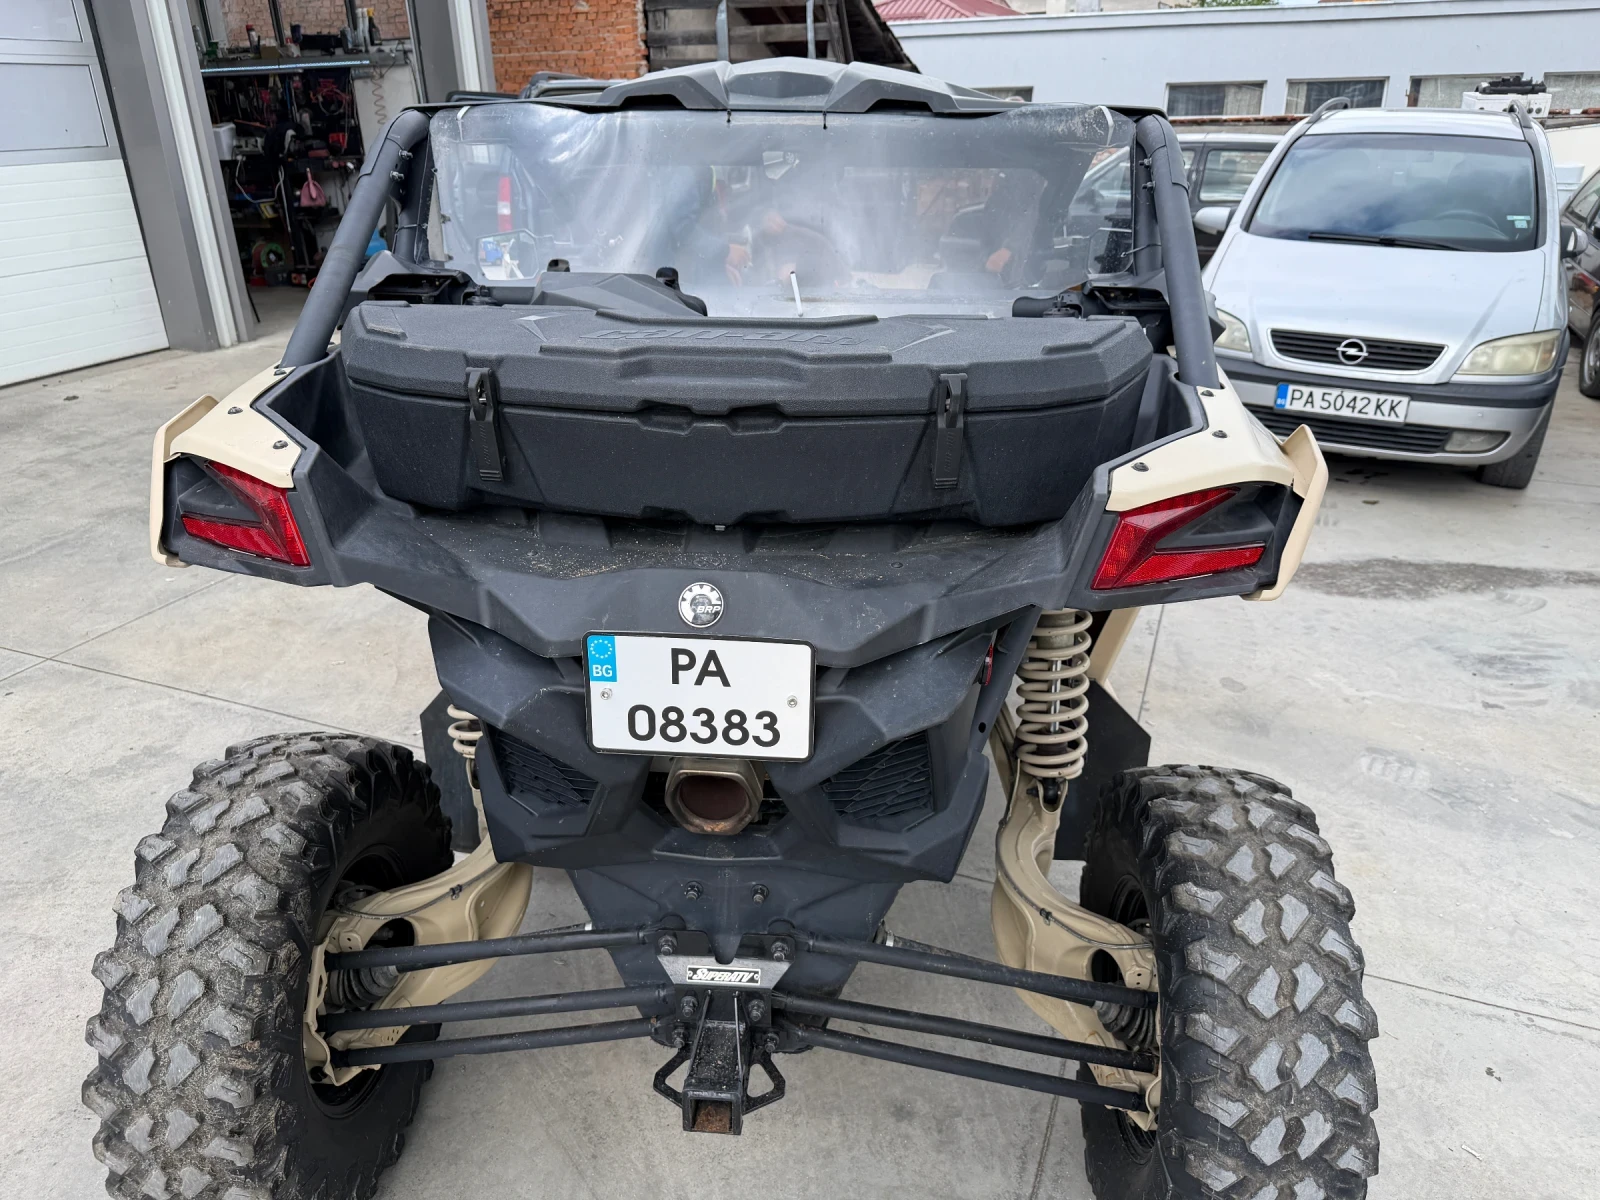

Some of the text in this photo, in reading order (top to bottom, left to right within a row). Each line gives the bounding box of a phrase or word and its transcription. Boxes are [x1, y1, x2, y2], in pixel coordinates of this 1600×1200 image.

[1289, 389, 1402, 418] PA 5042 KK
[696, 605, 722, 614] BRP
[592, 664, 613, 678] BG
[670, 647, 732, 688] PA
[627, 704, 781, 748] 08383
